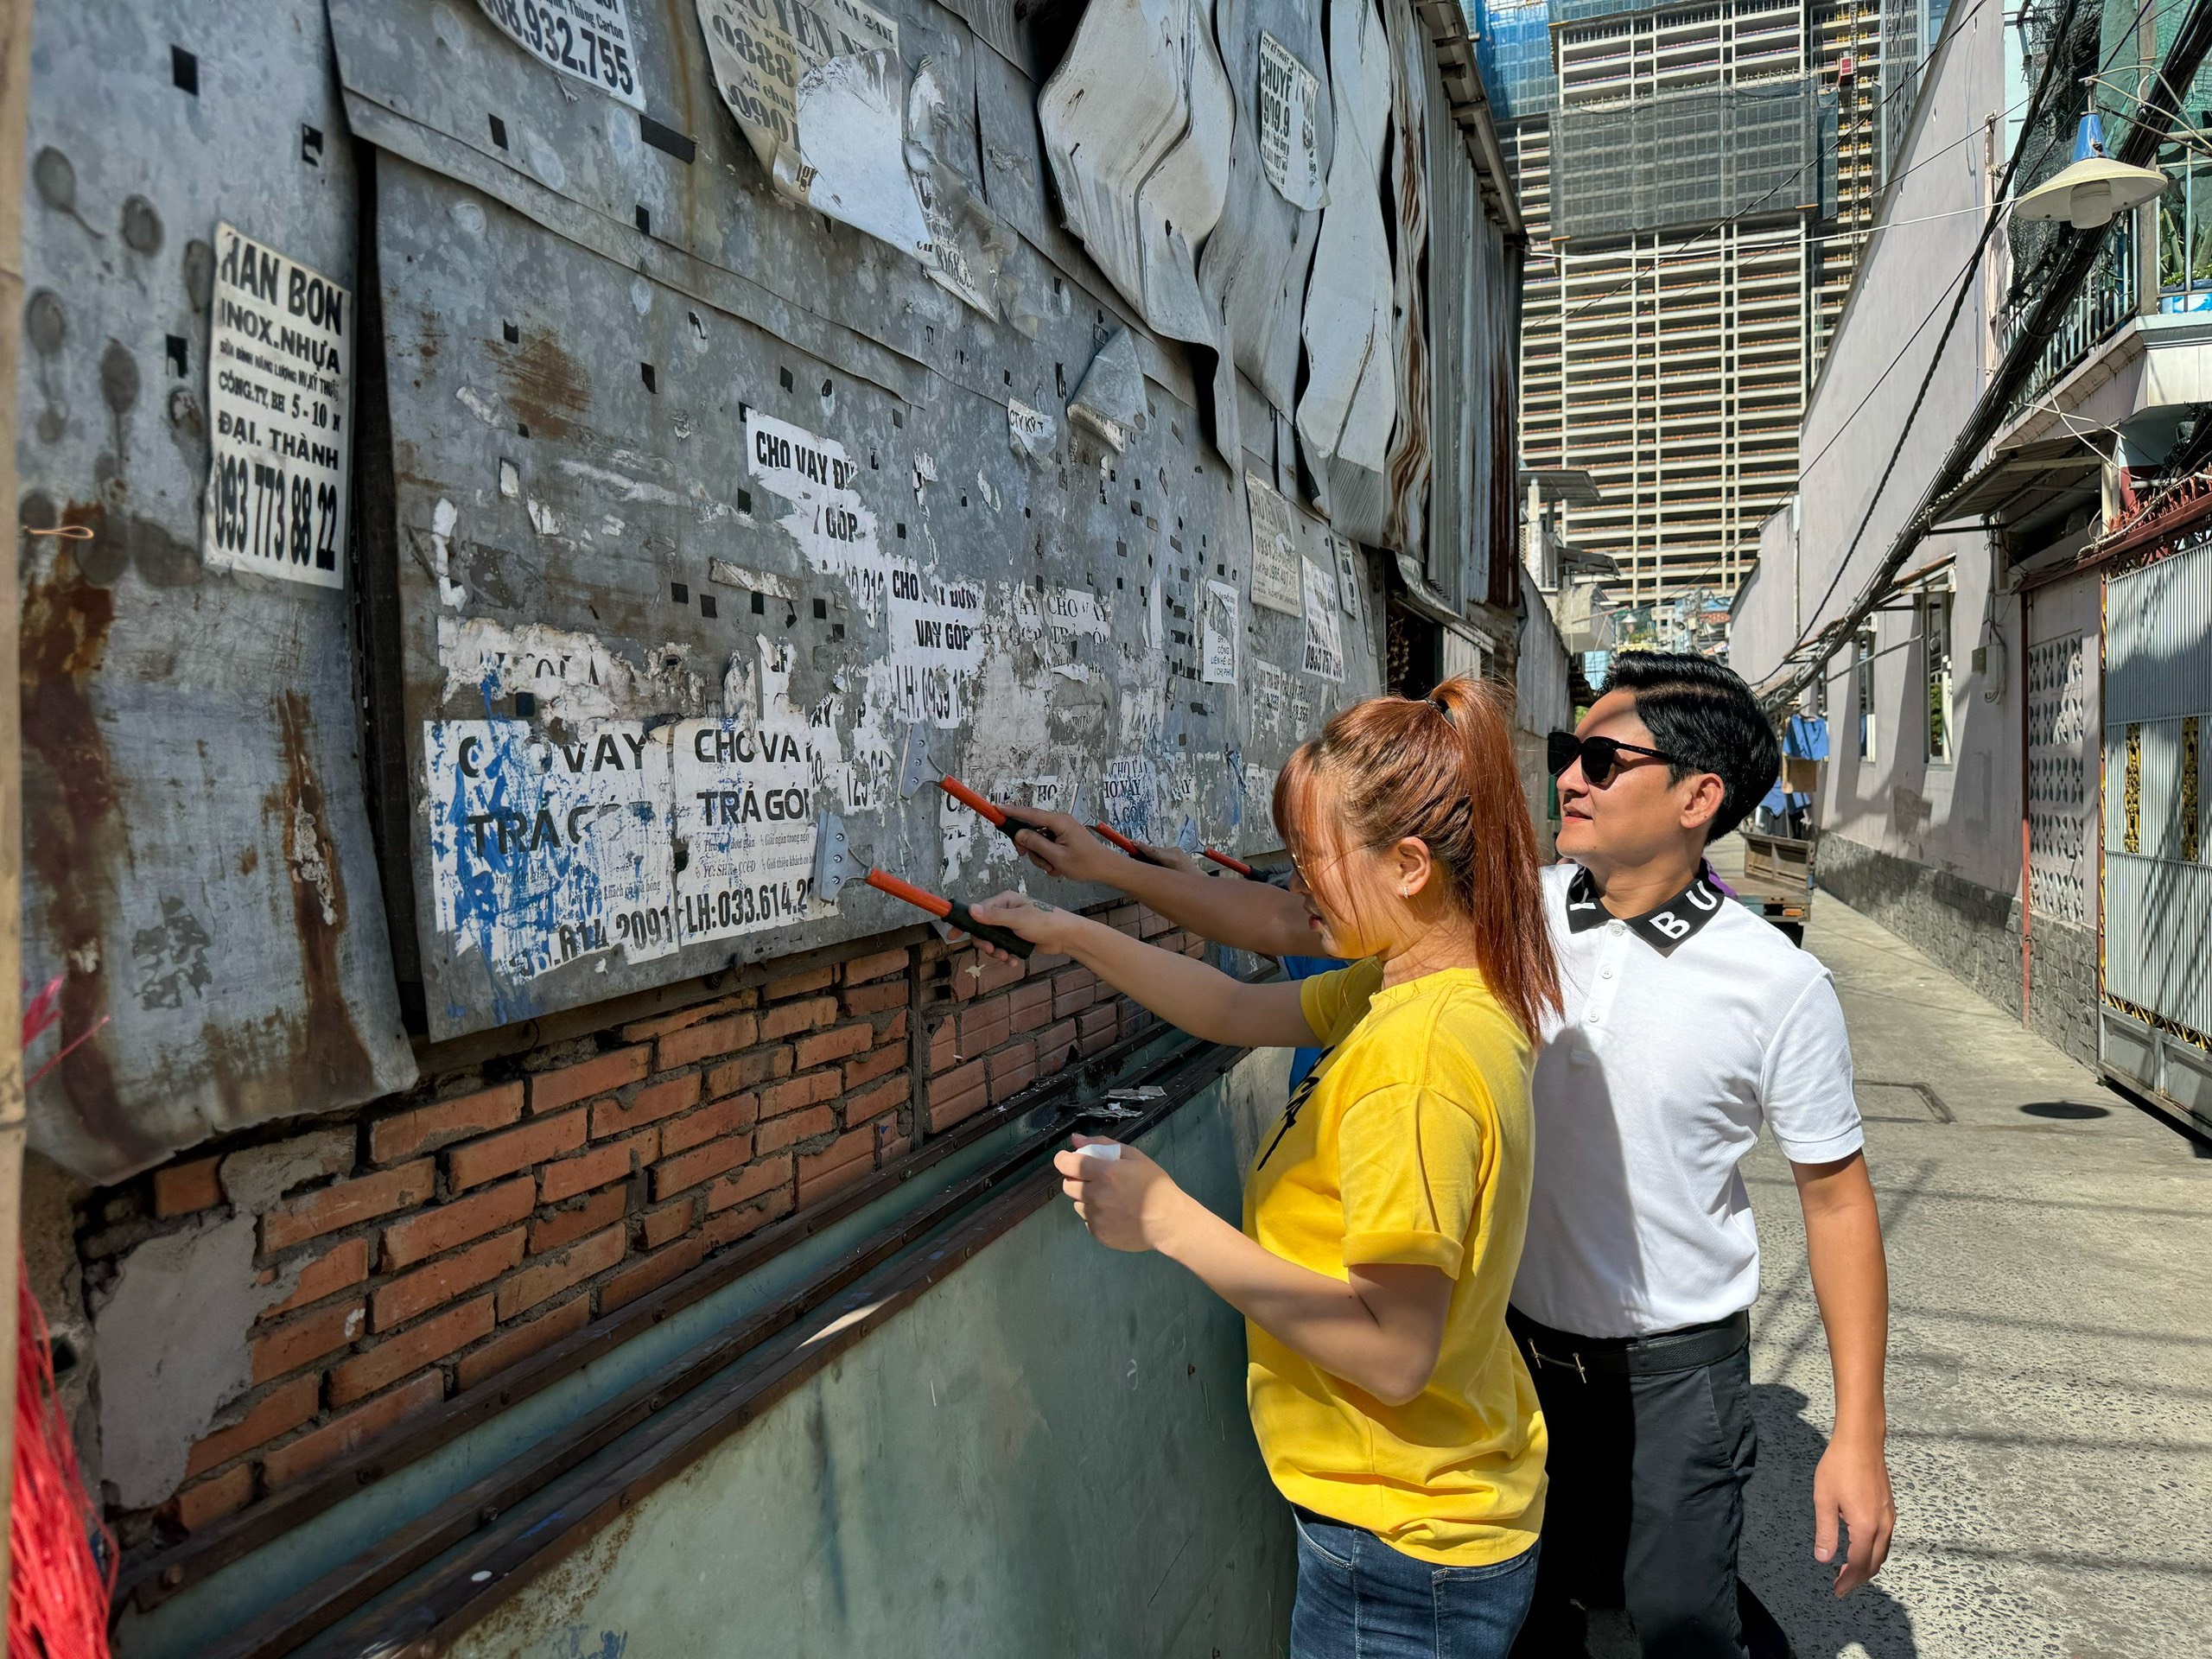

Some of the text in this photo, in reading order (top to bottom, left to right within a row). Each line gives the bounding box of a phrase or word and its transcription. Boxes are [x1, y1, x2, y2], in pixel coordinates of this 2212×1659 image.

[596, 12, 626, 41] Carton
[712, 15, 797, 88] 0888
[1261, 90, 1290, 138] 909.9
[288, 266, 343, 336] BON
[221, 298, 341, 375] INOX.NHỰA
[270, 391, 286, 413] BH
[291, 393, 301, 419] 5
[312, 401, 327, 429] 10
[1009, 410, 1024, 431] CTY
[269, 427, 339, 471] THÀNH
[756, 430, 791, 469] CHO
[794, 443, 829, 486] VAY
[215, 450, 338, 572] 093 773 88 22
[893, 569, 920, 602] CHO
[915, 619, 942, 649] VAY
[945, 619, 971, 652] GÓP
[560, 733, 646, 773] VAY
[694, 728, 756, 763] CHO
[466, 788, 563, 858] TRẢ
[696, 780, 763, 827] TRẢ
